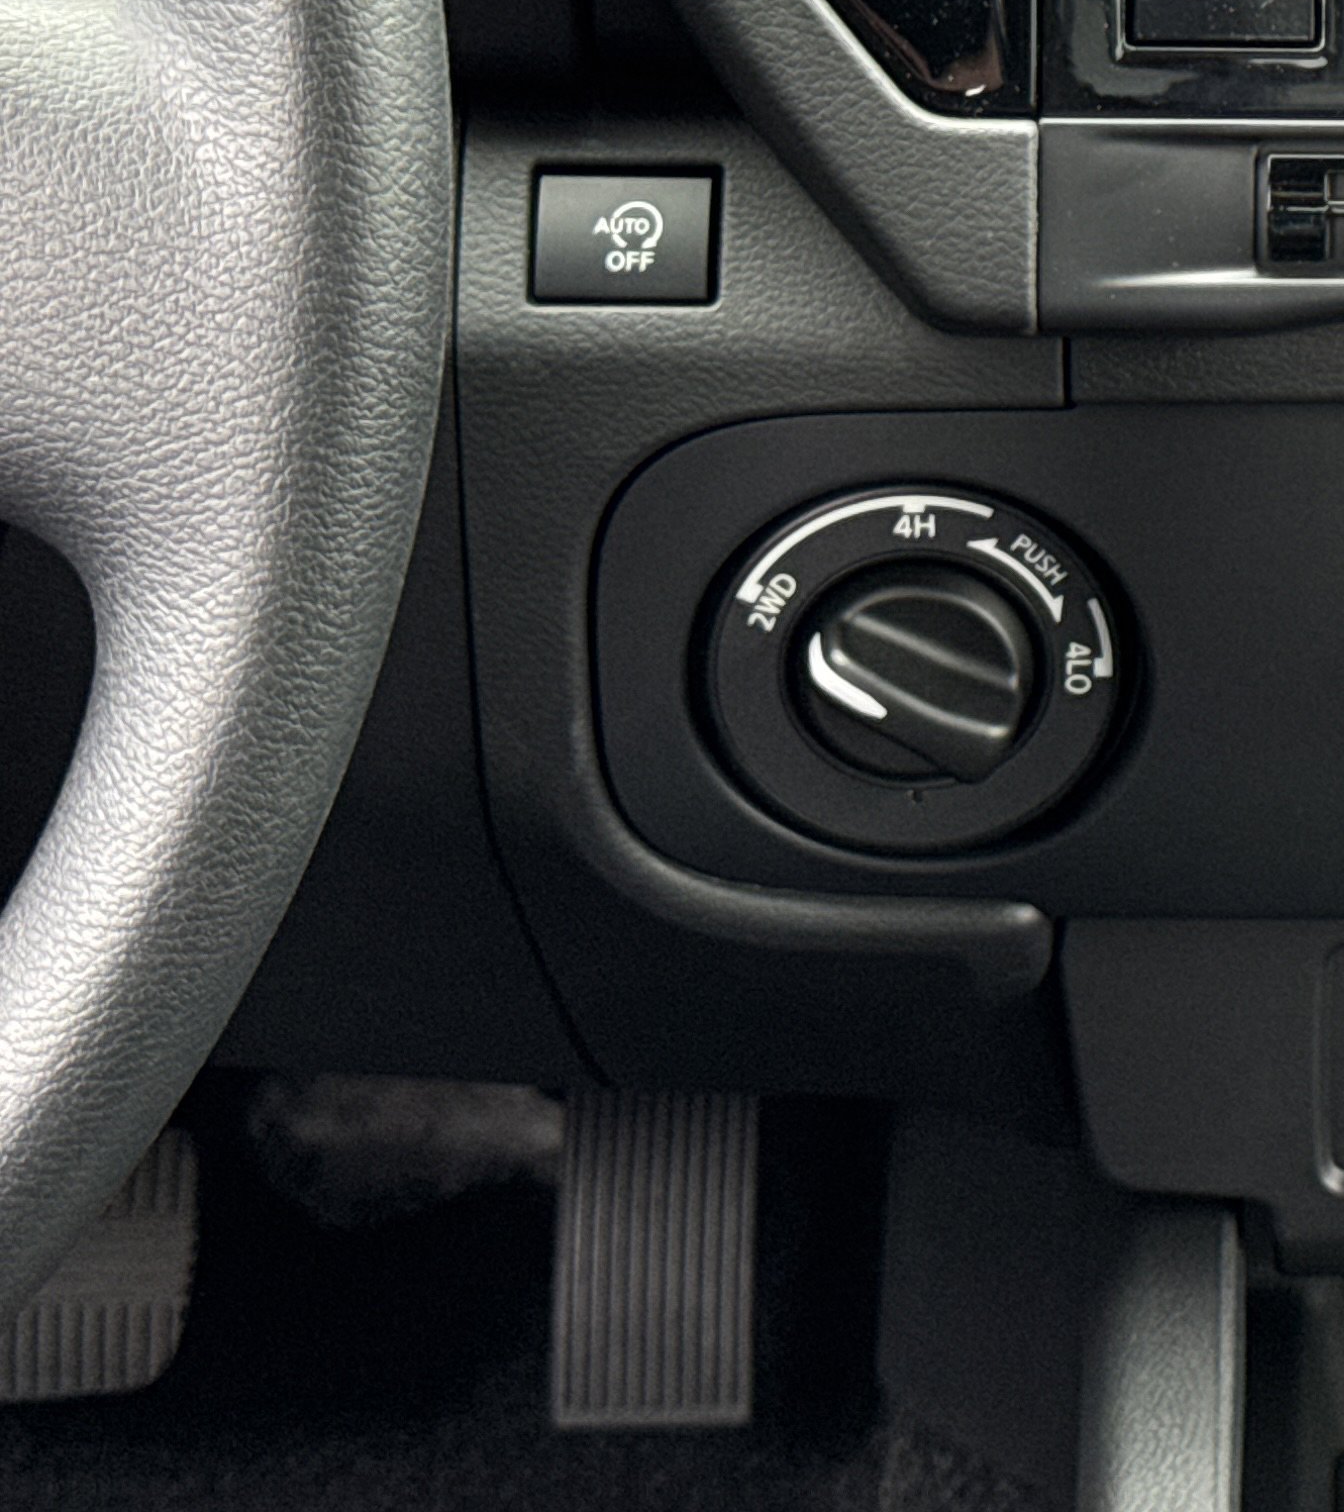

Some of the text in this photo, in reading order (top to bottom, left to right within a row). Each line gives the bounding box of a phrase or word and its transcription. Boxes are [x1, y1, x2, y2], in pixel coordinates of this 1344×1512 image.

[593, 215, 650, 236] AUTO
[605, 250, 656, 273] OFF
[893, 514, 936, 539] 4H
[1010, 533, 1068, 587] PUSH
[747, 572, 798, 632] 2WD
[1065, 640, 1093, 695] 4LO
